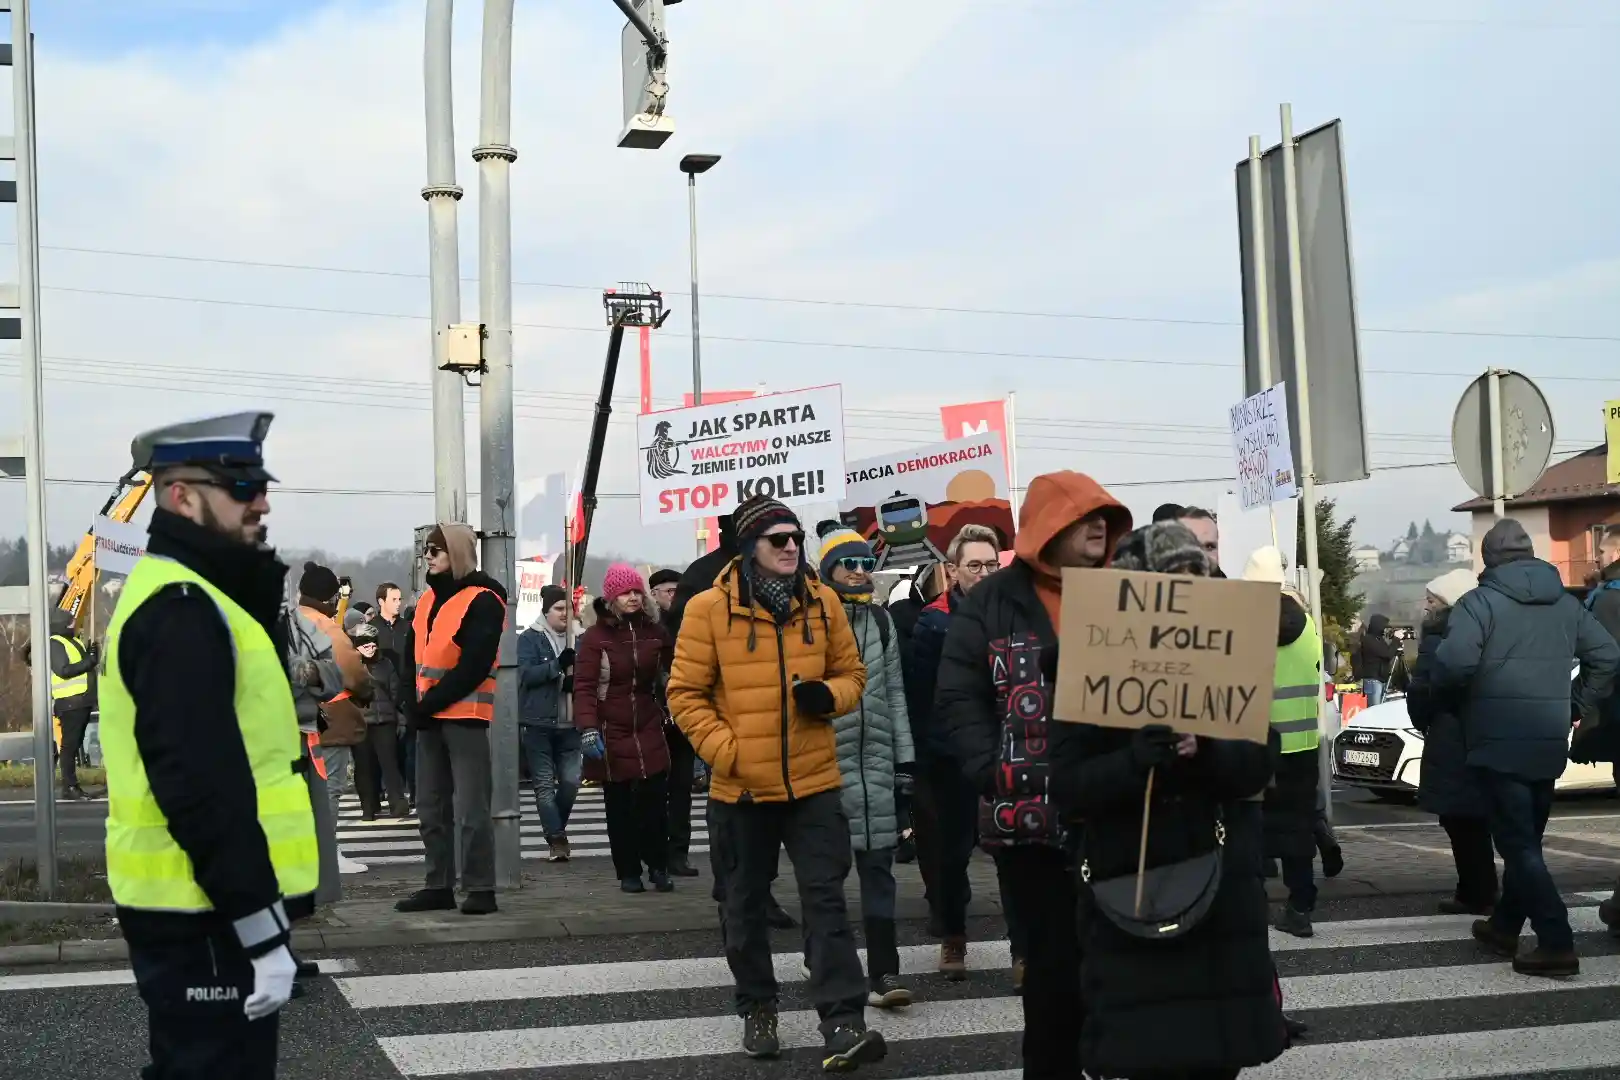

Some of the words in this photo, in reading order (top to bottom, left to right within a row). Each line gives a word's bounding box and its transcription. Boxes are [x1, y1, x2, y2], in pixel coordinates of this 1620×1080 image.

[688, 416, 728, 439] JAK
[732, 404, 816, 432] SPARTA
[690, 439, 769, 461] WALCZYMY
[772, 437, 783, 449] O
[786, 430, 832, 447] NASZE
[896, 444, 993, 473] DEMOKRACJA
[691, 458, 736, 476] ZIEMIE
[739, 457, 743, 469] I
[746, 451, 790, 468] DOMY
[658, 483, 729, 514] STOP
[736, 469, 825, 504] KOLEI!
[1117, 578, 1193, 614] NIE
[1085, 623, 1138, 650] DLA
[1149, 625, 1233, 656] KOLEI
[1129, 658, 1194, 676] PRZEZ
[1081, 675, 1258, 725] MOGILANY
[186, 986, 239, 1001] POLICJA
